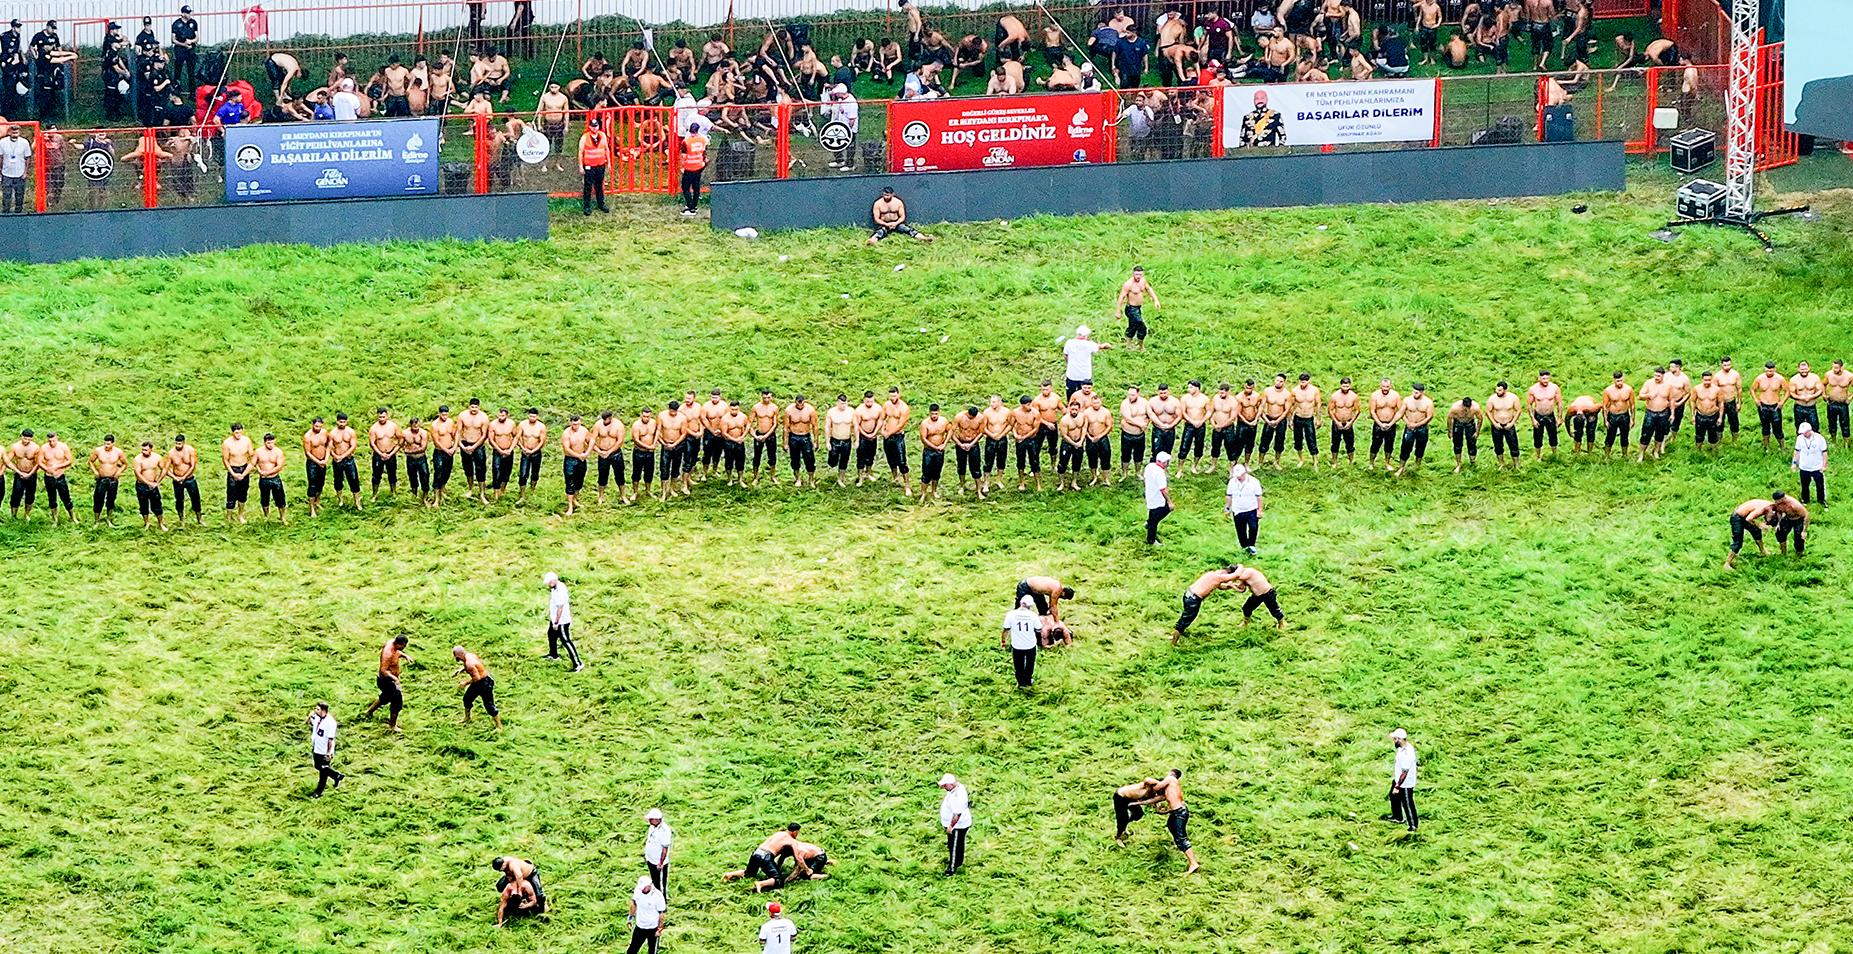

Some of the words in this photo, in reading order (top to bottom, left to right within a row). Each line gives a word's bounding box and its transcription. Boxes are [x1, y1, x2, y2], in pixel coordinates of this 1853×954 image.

[1367, 88, 1415, 96] KAHRAMANI
[1316, 98, 1333, 106] TÜM
[948, 119, 959, 127] ER
[960, 116, 997, 126] MEYDANI
[997, 114, 1049, 124] KIRKPINAR'A
[1297, 109, 1370, 121] BAŞARILAR
[282, 133, 293, 141] ER
[293, 131, 329, 140] MEYDANI
[329, 129, 382, 139] KIRKPINAR'IN
[941, 130, 976, 147] HOŞ
[978, 123, 1056, 143] GELDİNİZ
[280, 140, 306, 151] YİĞİT
[306, 139, 384, 150] PEHLİVANLARINA
[270, 151, 340, 166] BAŞARILAR
[340, 148, 393, 161] DİLERİM
[1016, 621, 1029, 632] 11
[776, 934, 781, 944] 1
